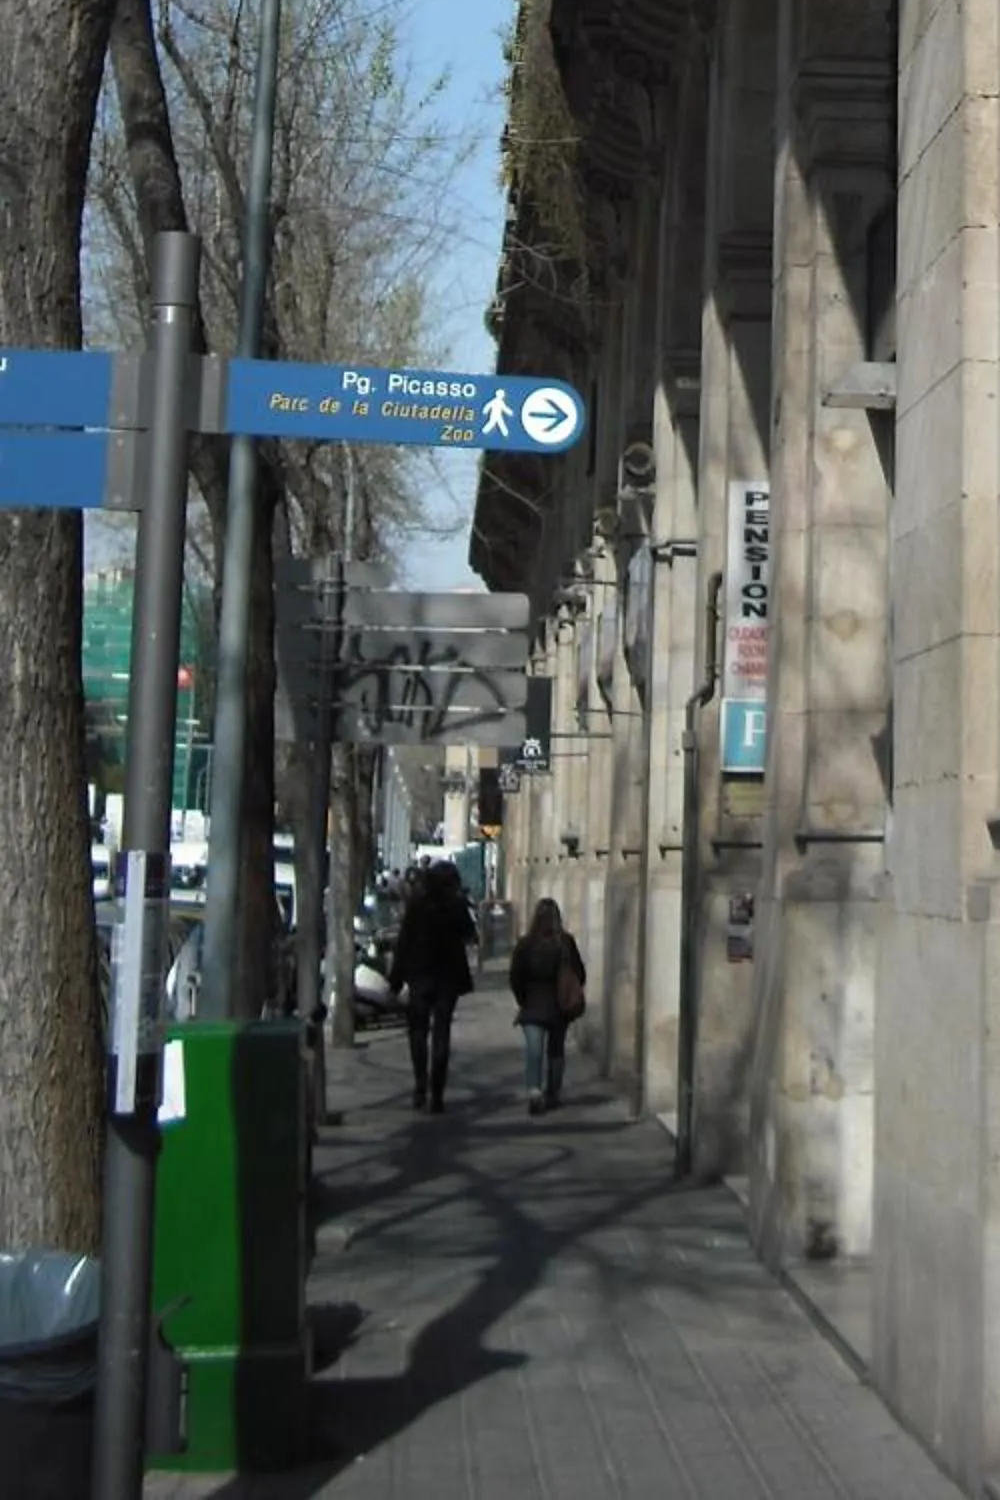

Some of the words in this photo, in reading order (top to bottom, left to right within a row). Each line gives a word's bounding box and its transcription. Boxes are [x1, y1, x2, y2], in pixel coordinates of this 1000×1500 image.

[342, 371, 377, 395] Pg.
[388, 373, 476, 398] Picasso
[269, 393, 309, 412] Parc
[319, 396, 341, 414] de
[352, 399, 370, 416] la
[381, 400, 475, 422] Ciutadella
[440, 425, 474, 442] Zoo
[741, 490, 769, 619] PENSION
